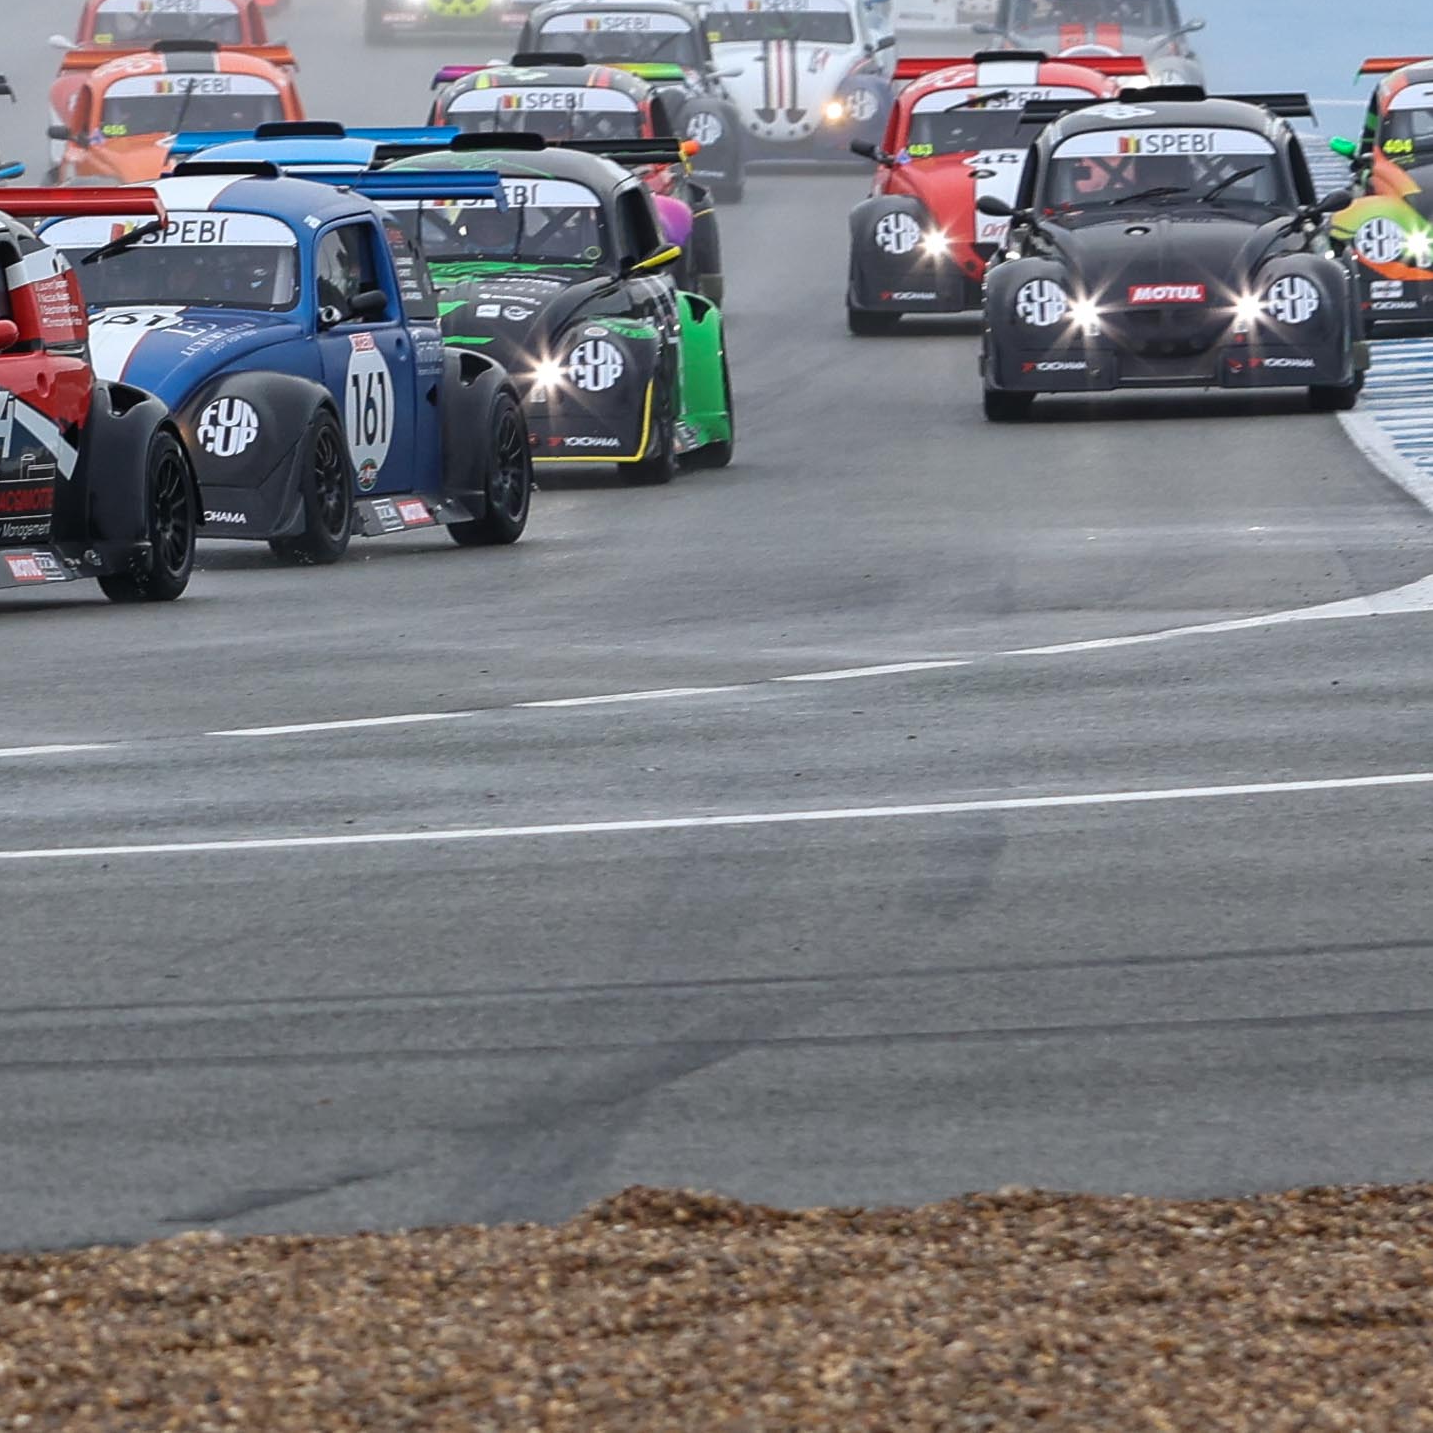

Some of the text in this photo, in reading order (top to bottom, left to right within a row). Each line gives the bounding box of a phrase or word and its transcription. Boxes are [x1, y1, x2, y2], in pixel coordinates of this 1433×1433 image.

[1132, 284, 1202, 302] MOTUL
[200, 397, 259, 426] FUN
[352, 371, 386, 447] 161
[197, 425, 258, 457] CUP
